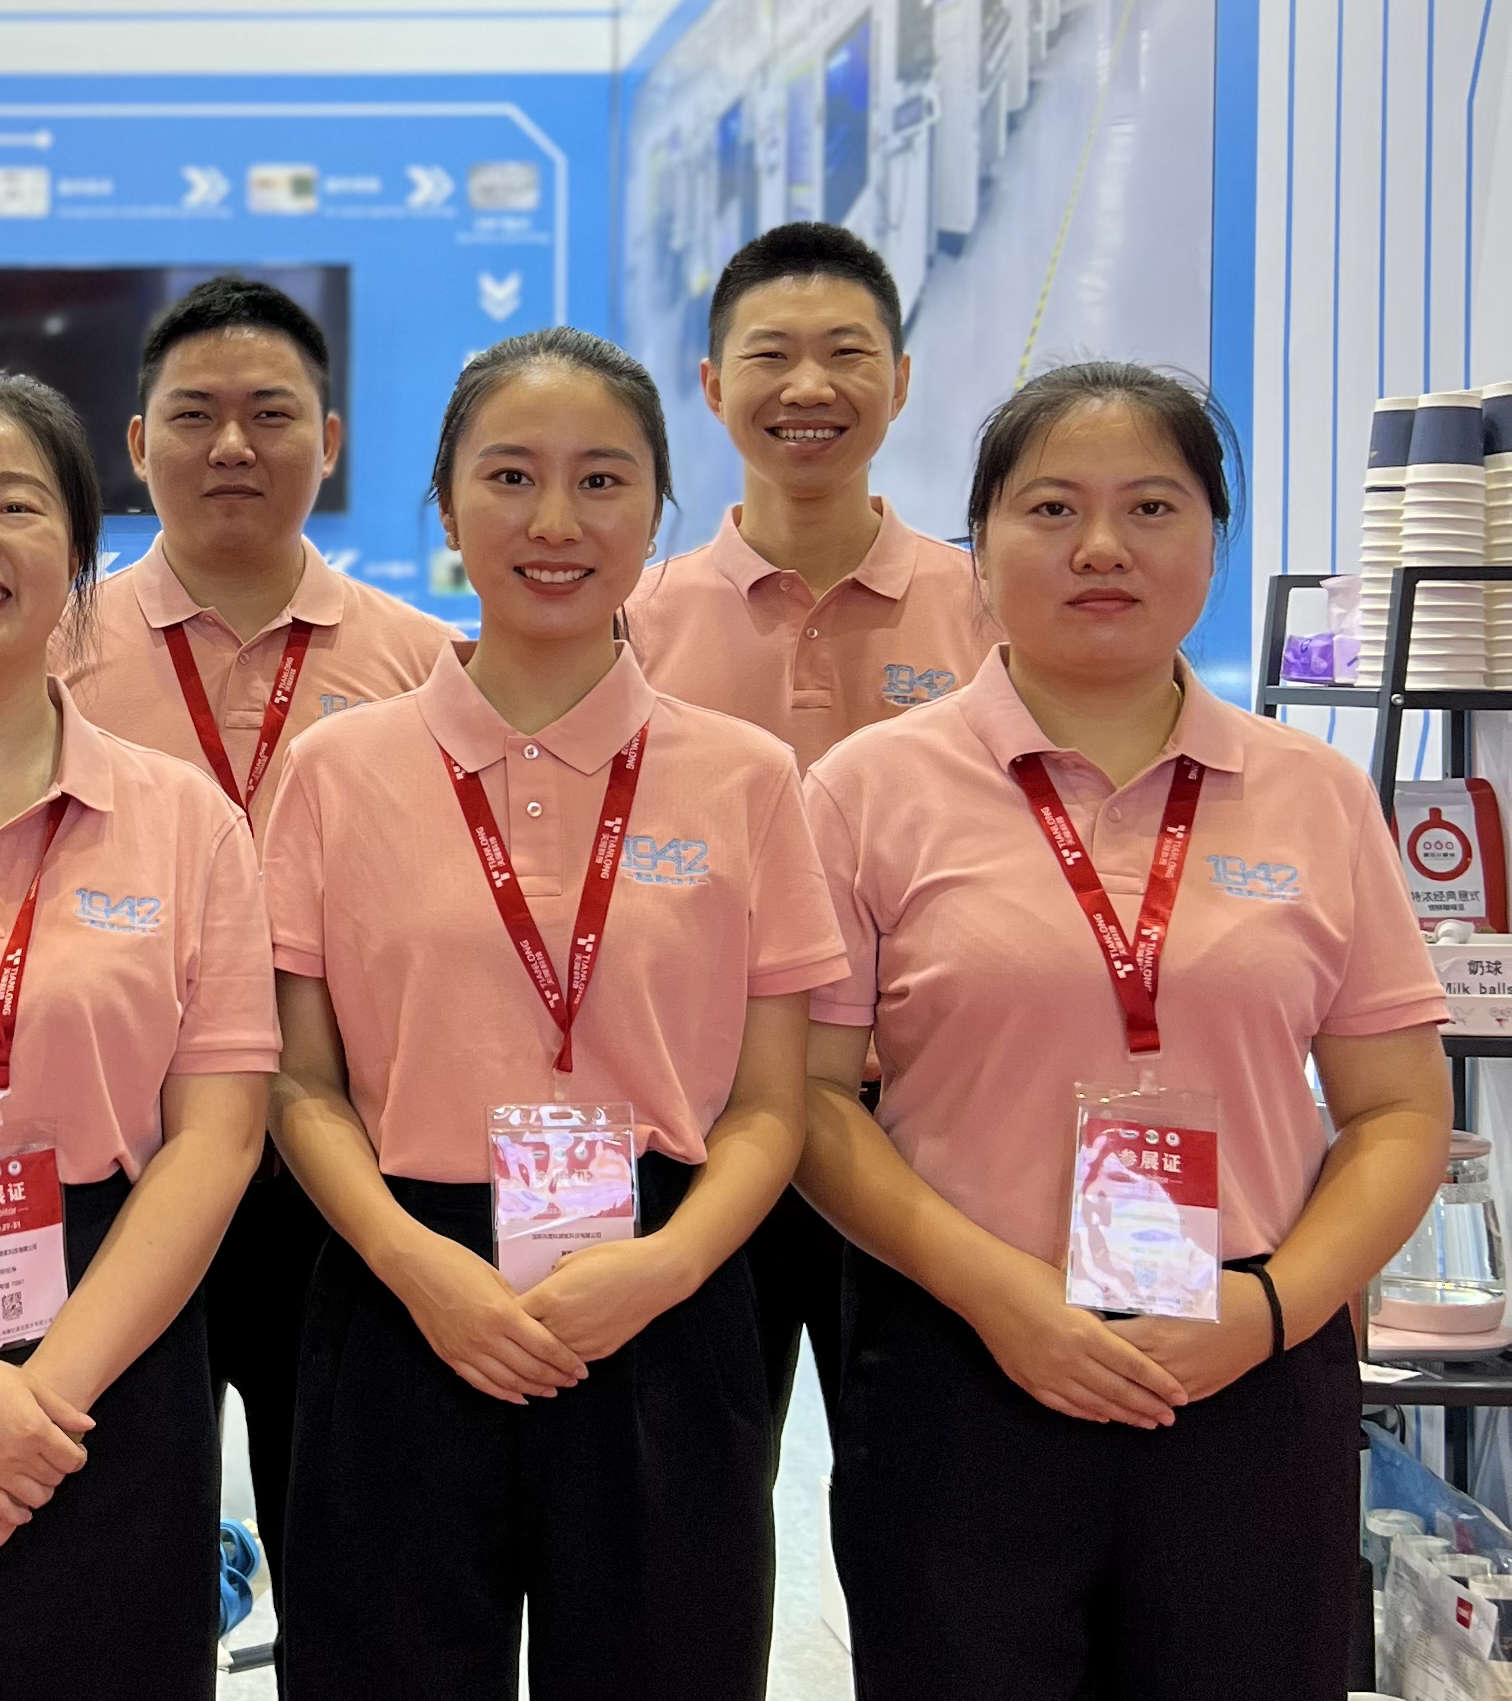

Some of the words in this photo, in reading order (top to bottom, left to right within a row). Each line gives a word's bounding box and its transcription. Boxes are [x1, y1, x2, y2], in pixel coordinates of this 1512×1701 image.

[621, 836, 709, 875] 1942
[1205, 855, 1299, 893] 1942
[75, 888, 161, 926] 1942
[1467, 960, 1503, 975] 奶球
[1118, 1148, 1183, 1173] 参展证
